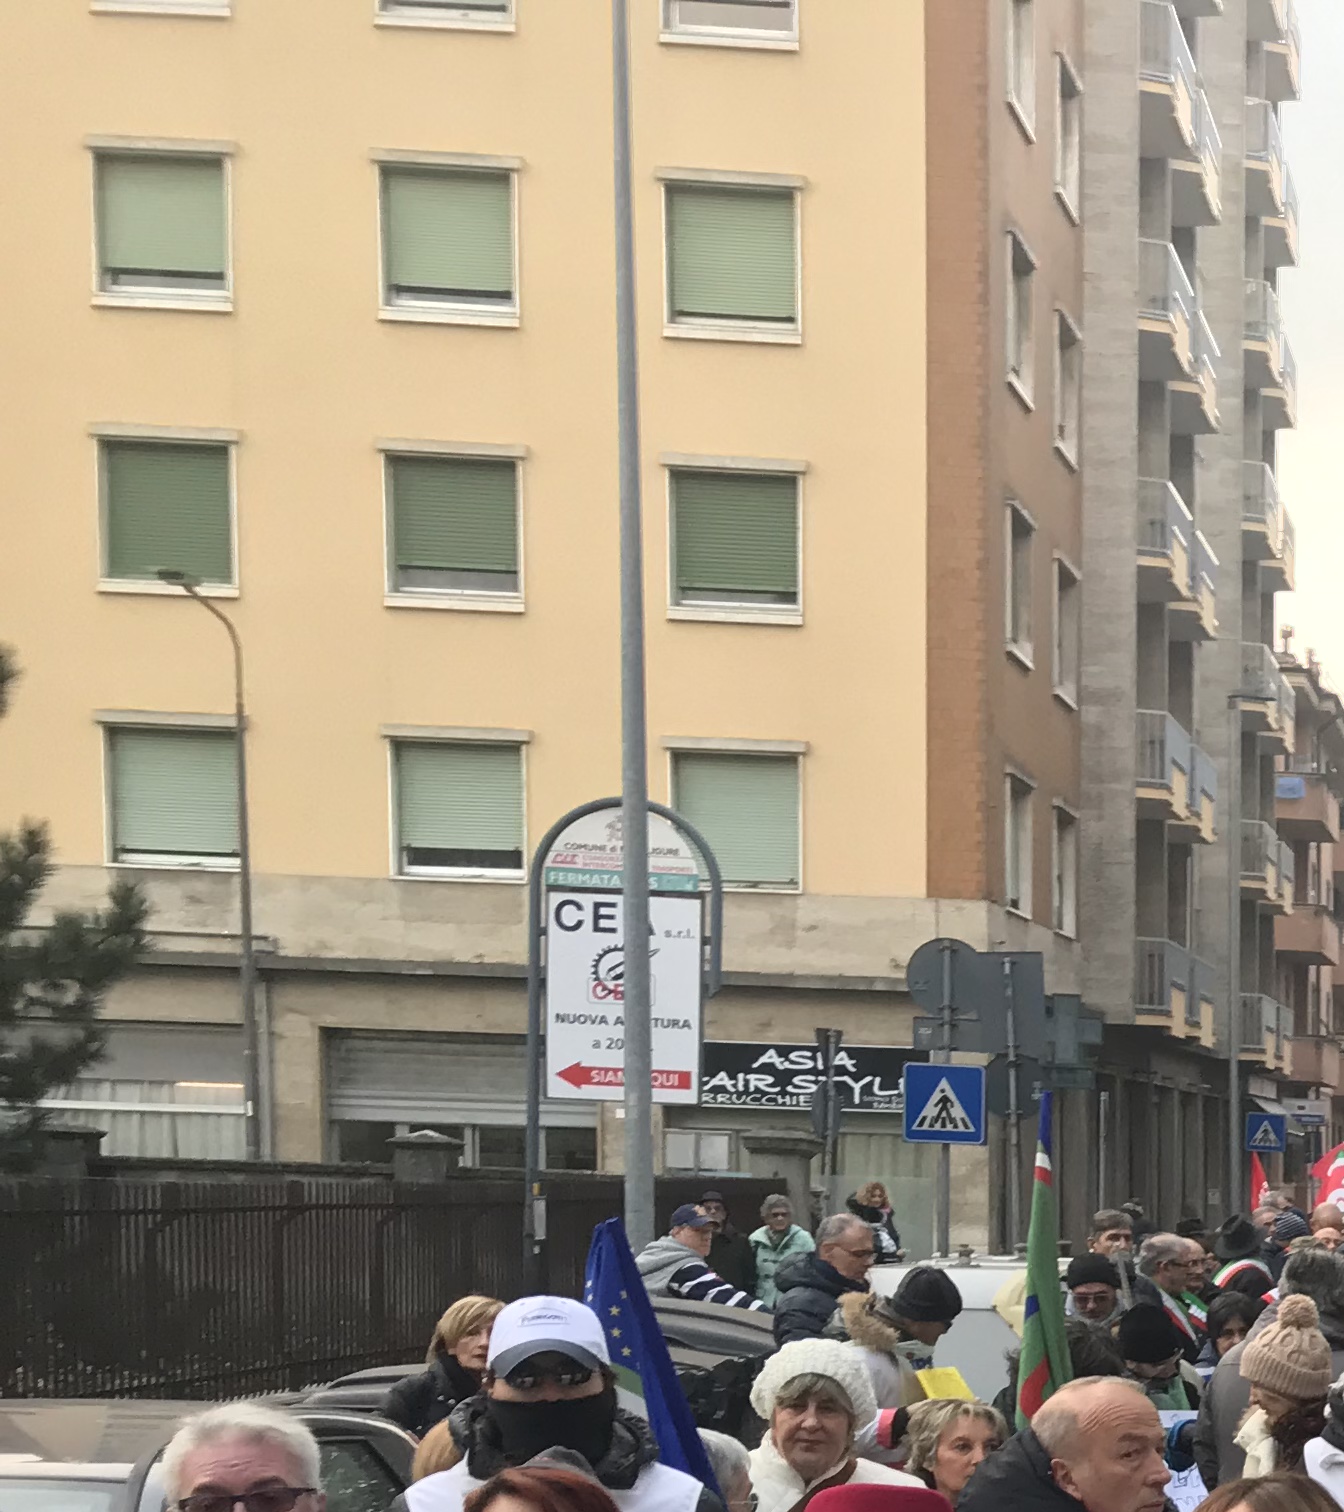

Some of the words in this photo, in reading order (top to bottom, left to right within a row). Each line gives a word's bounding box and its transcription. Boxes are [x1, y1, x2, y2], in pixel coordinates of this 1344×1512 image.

[549, 871, 623, 887] FERMATA
[554, 1012, 609, 1027] NUOVA
[591, 1038, 602, 1050] a
[752, 1048, 857, 1073] ASIA
[702, 1071, 782, 1093] AIR
[701, 1092, 812, 1107] RRUCCHIE
